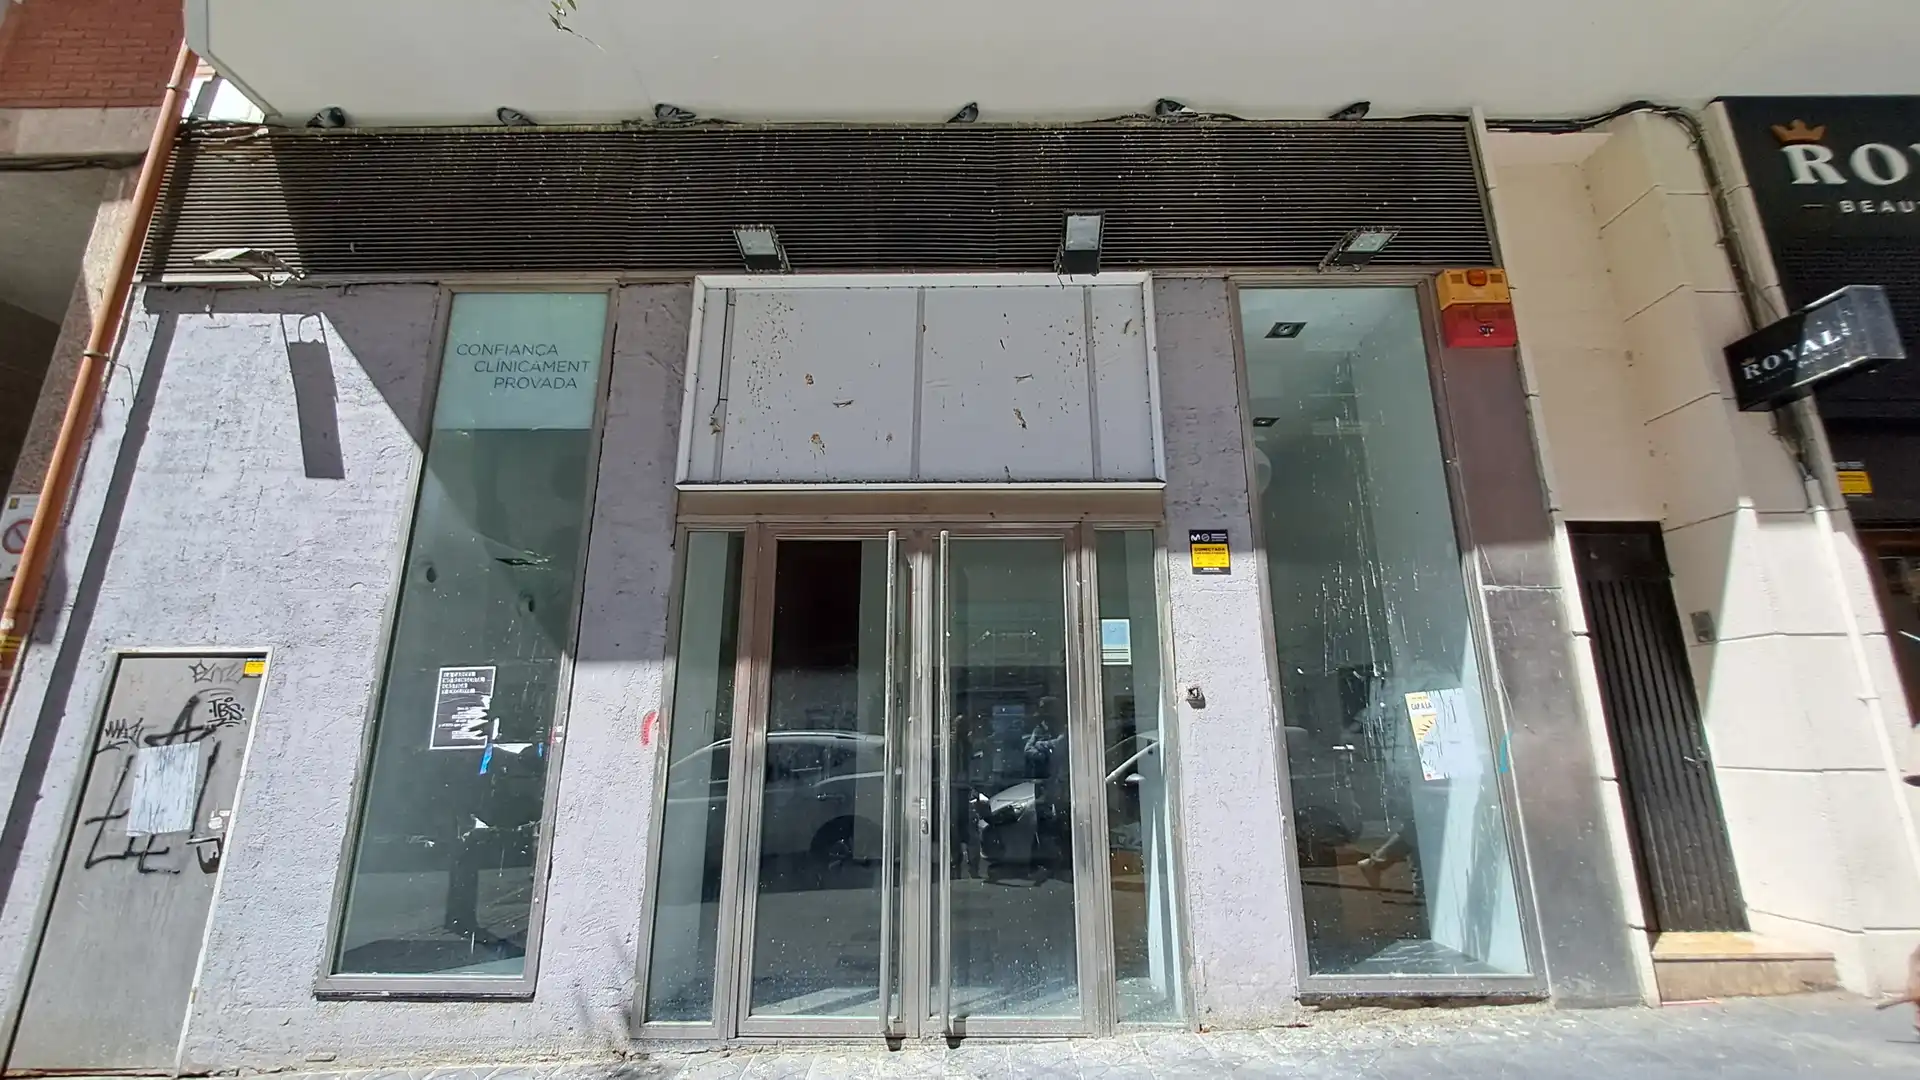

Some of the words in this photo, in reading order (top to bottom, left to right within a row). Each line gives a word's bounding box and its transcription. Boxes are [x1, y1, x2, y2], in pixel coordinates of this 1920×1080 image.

[1779, 143, 1920, 186] RO
[1839, 199, 1920, 214] BEAU
[456, 344, 559, 357] CONFIANÇA
[1743, 329, 1842, 380] ROYAL
[493, 377, 577, 389] PROVADA
